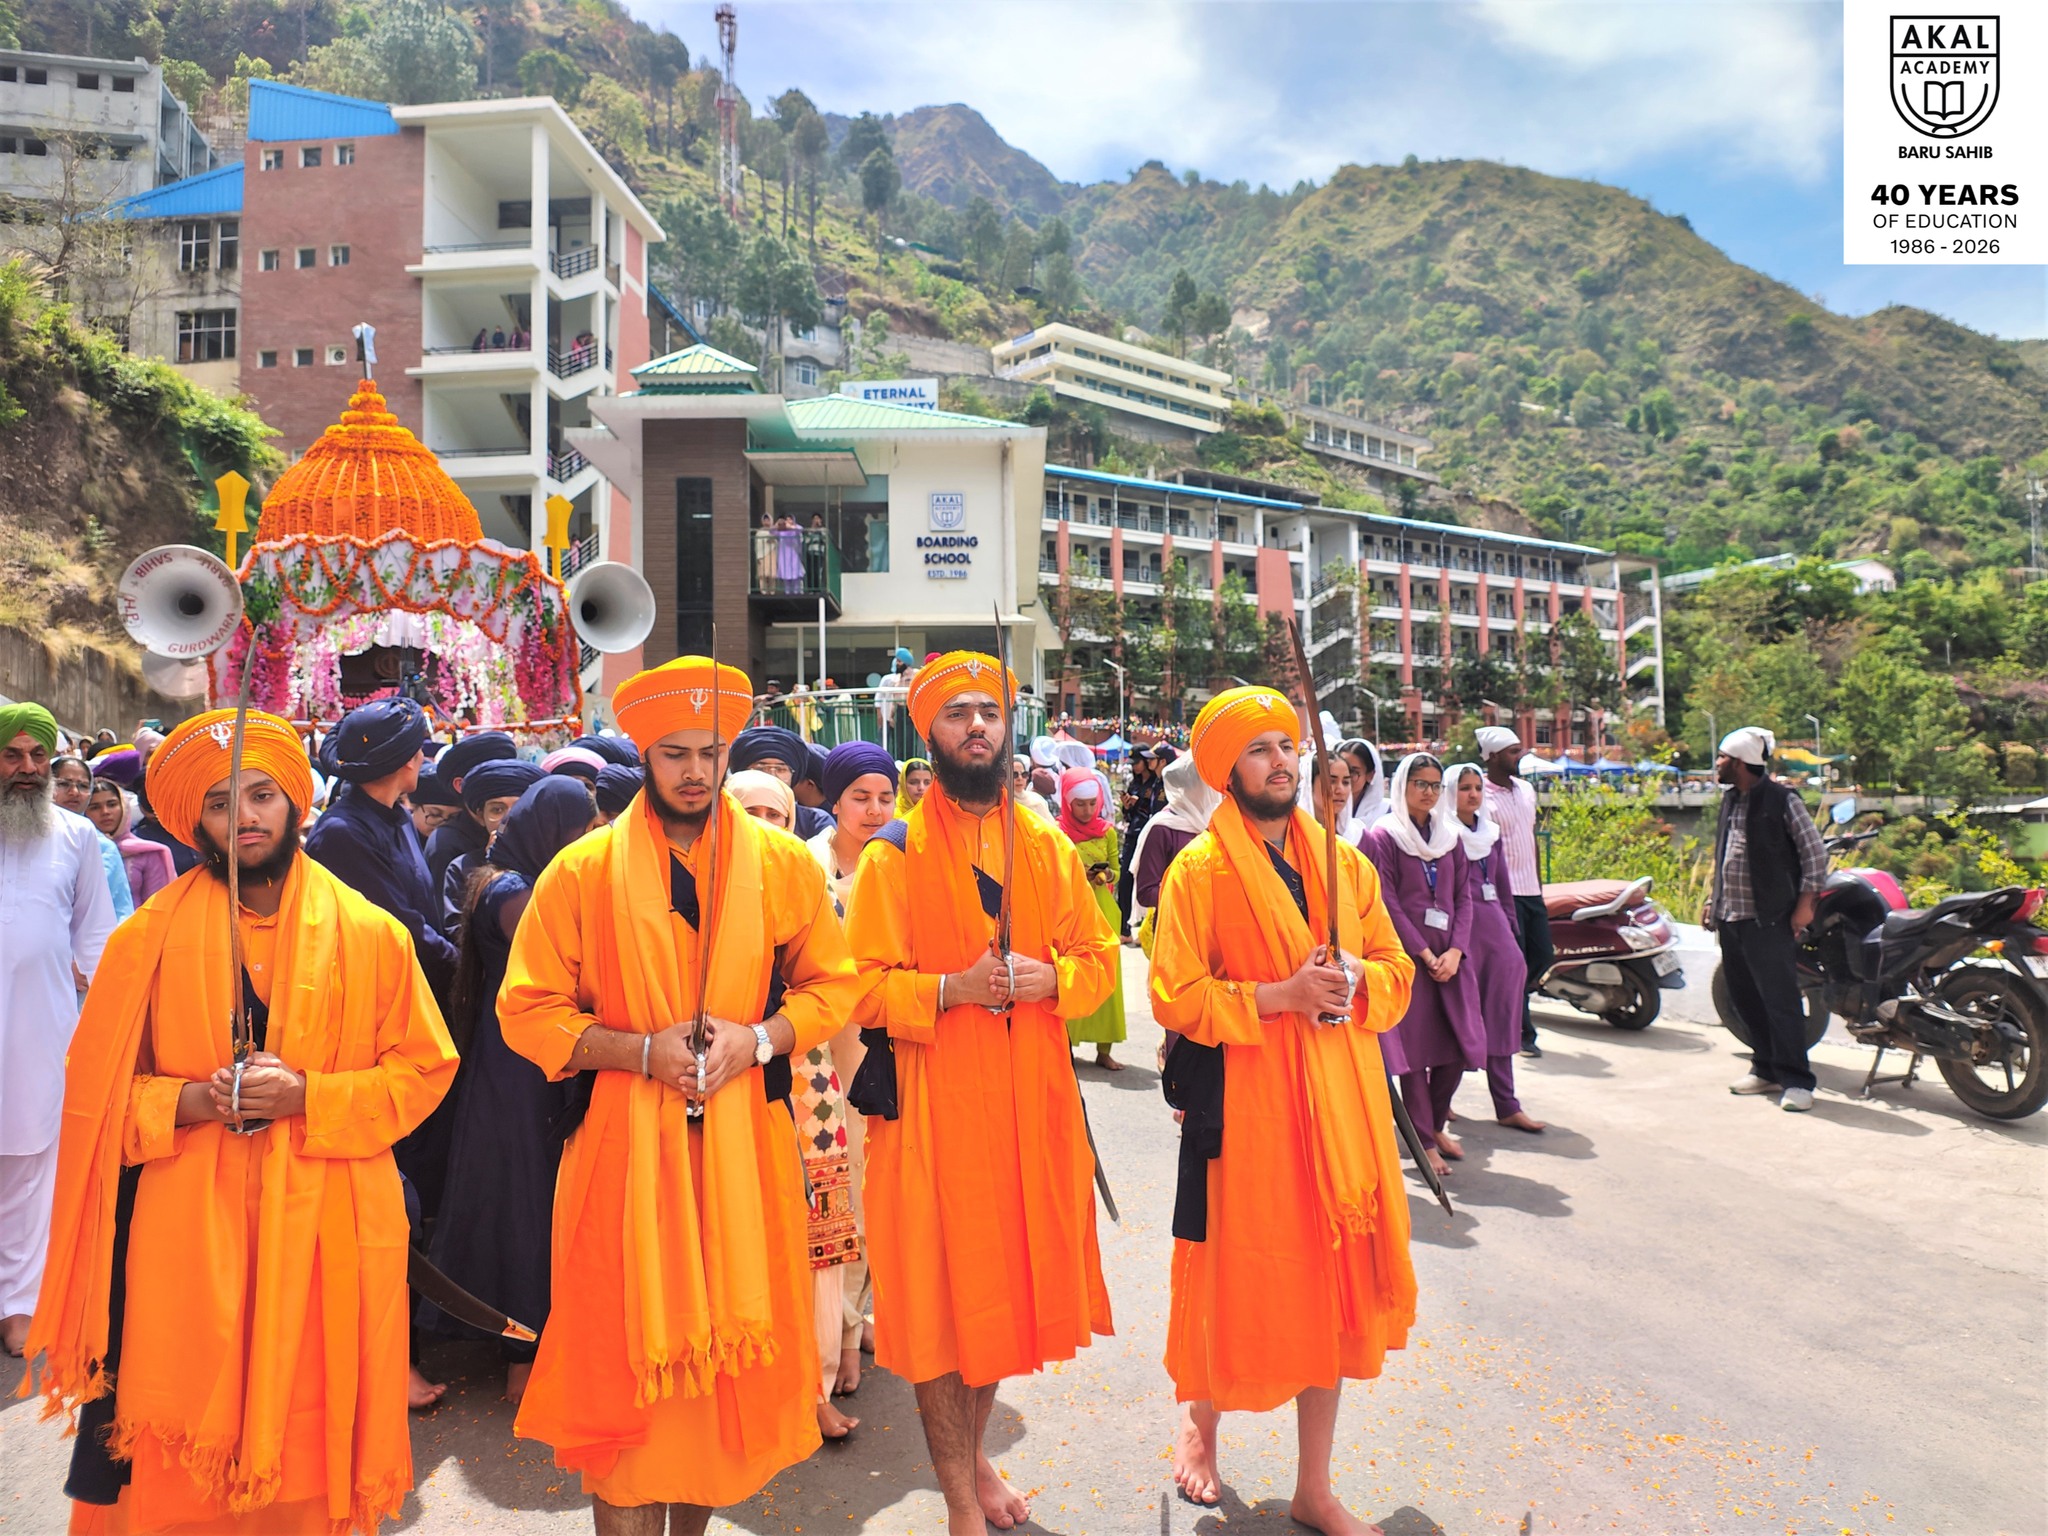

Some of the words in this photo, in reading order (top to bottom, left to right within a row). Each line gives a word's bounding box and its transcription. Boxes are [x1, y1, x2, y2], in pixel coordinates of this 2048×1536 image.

[863, 387, 926, 400] ETERNAL
[916, 536, 979, 548] BOARDING
[924, 552, 972, 565] SCHOOL
[134, 552, 173, 579] SAHIB
[167, 612, 236, 653] GURDWARA
